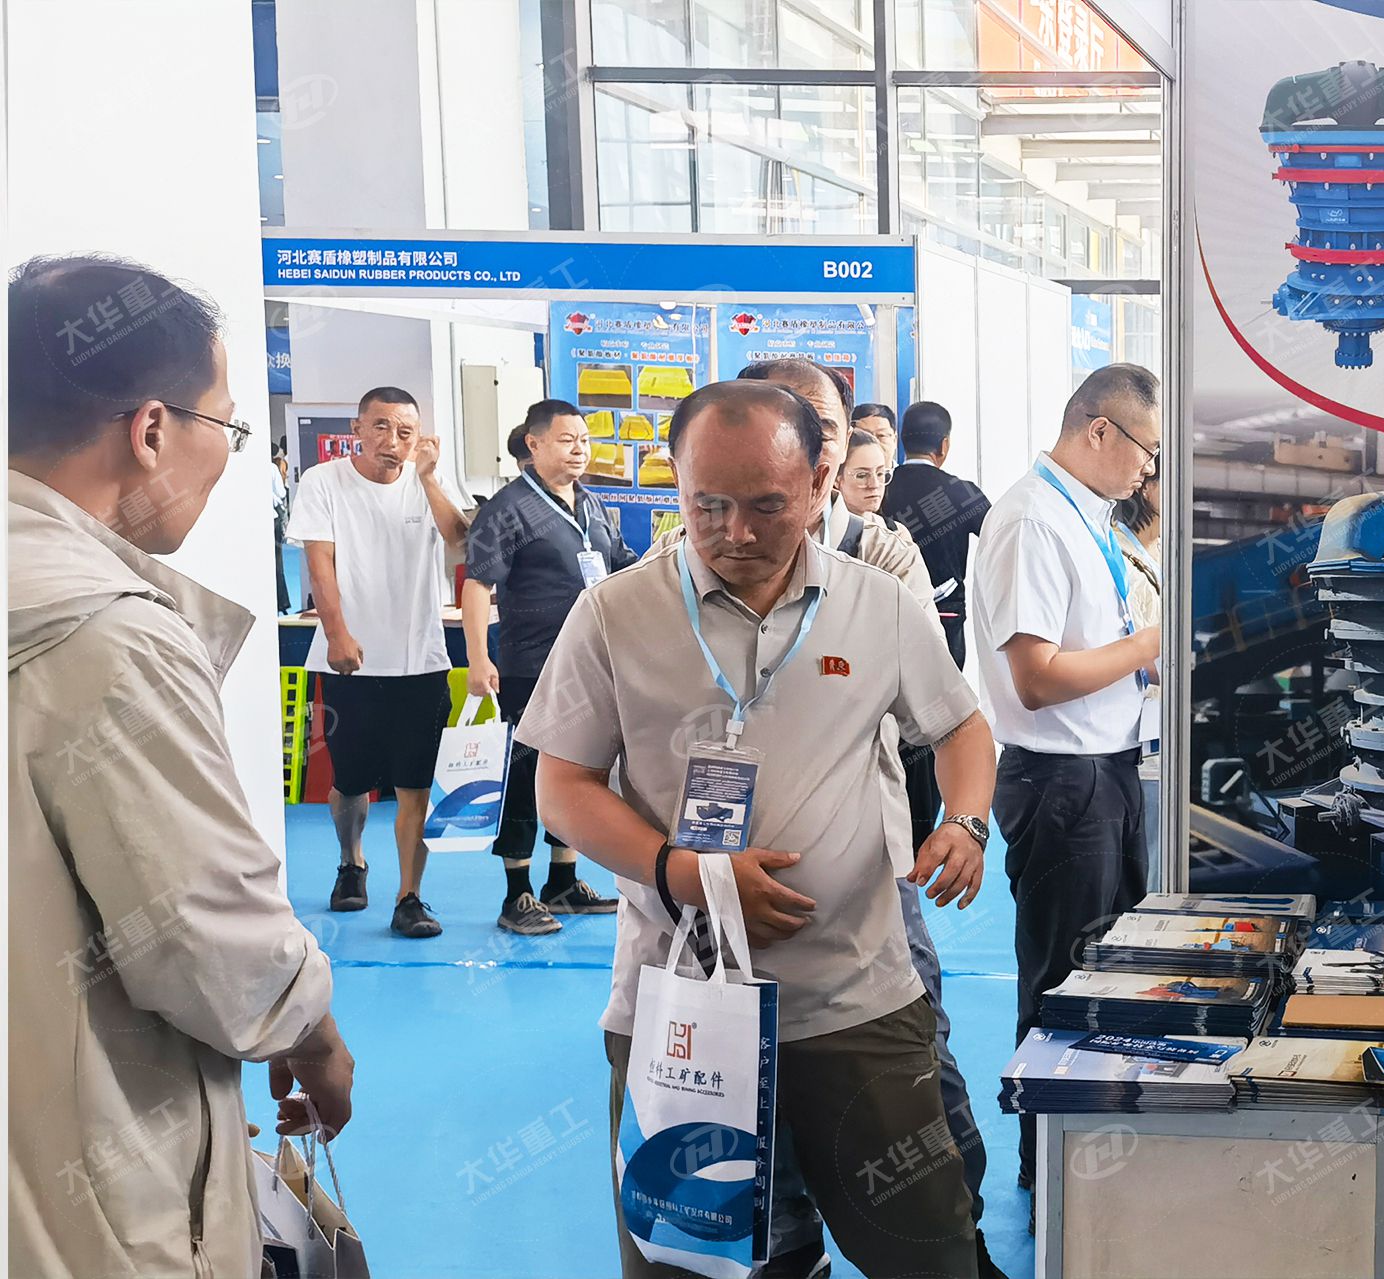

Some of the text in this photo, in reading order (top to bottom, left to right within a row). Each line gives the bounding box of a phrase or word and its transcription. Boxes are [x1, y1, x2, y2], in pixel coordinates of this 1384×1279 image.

[277, 250, 458, 267] 河北赛盾橡塑制品有限公司
[277, 269, 521, 282] HEBEI SAIDUN RUBBER PRODUCTS CO., LTD
[823, 261, 873, 278] B002
